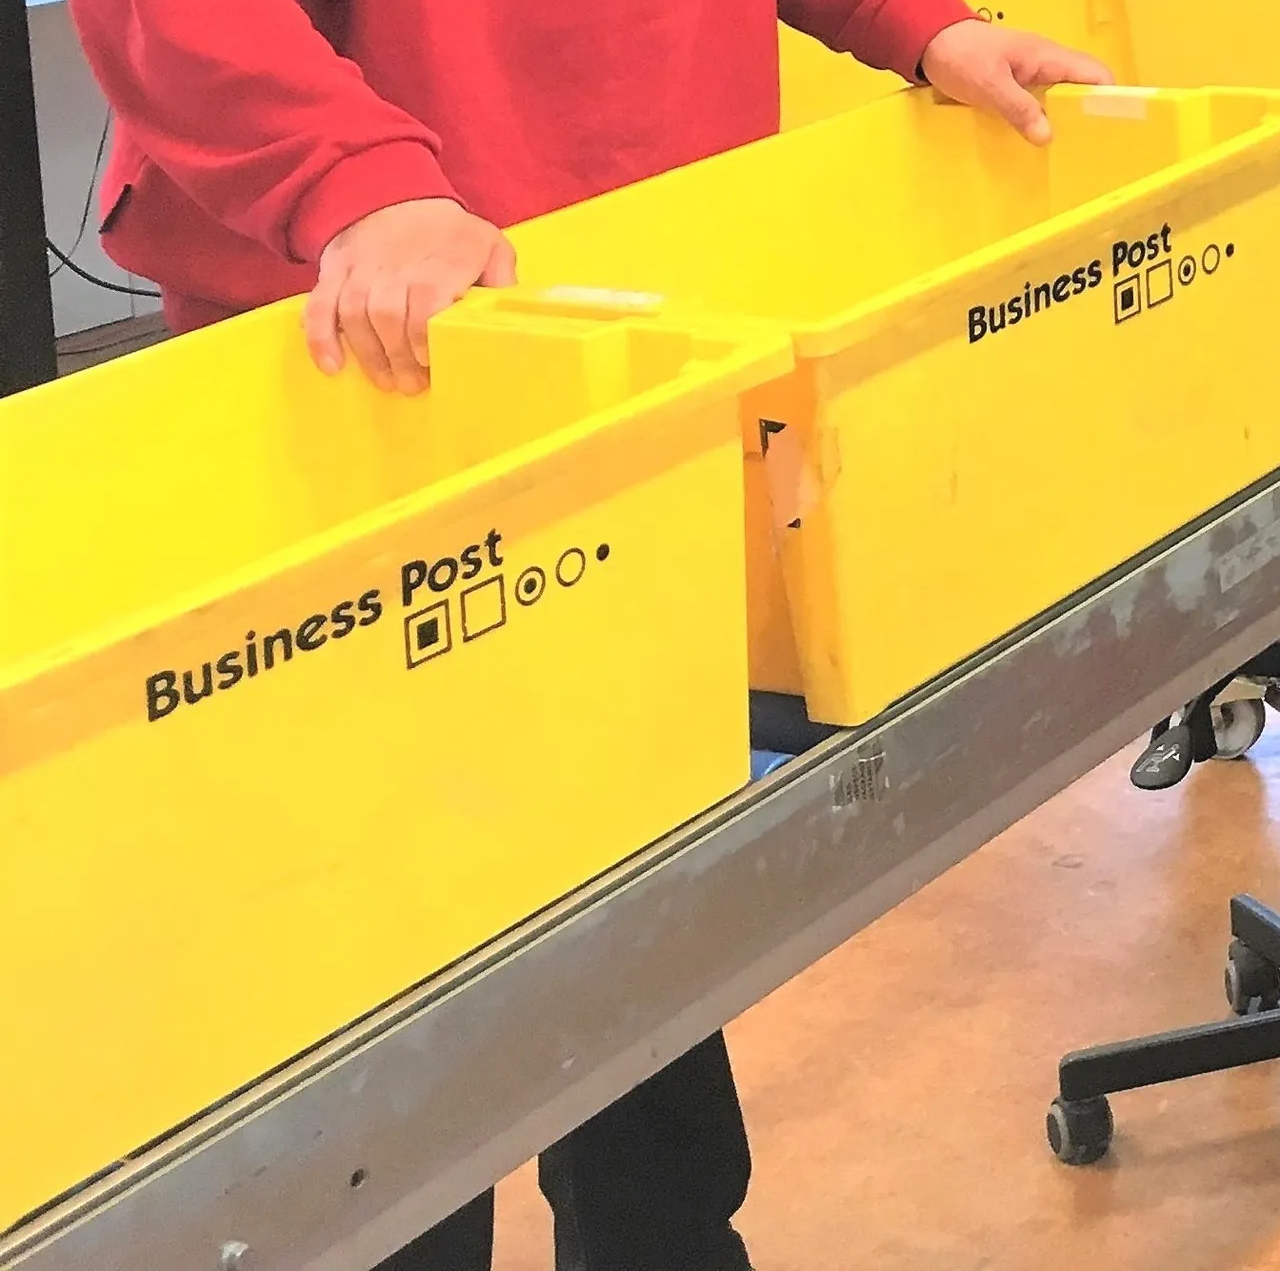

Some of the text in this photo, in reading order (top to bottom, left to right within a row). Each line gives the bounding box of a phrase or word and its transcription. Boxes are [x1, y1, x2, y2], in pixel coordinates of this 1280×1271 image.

[967, 222, 1172, 344] Business Post
[145, 528, 505, 723] Business Post
